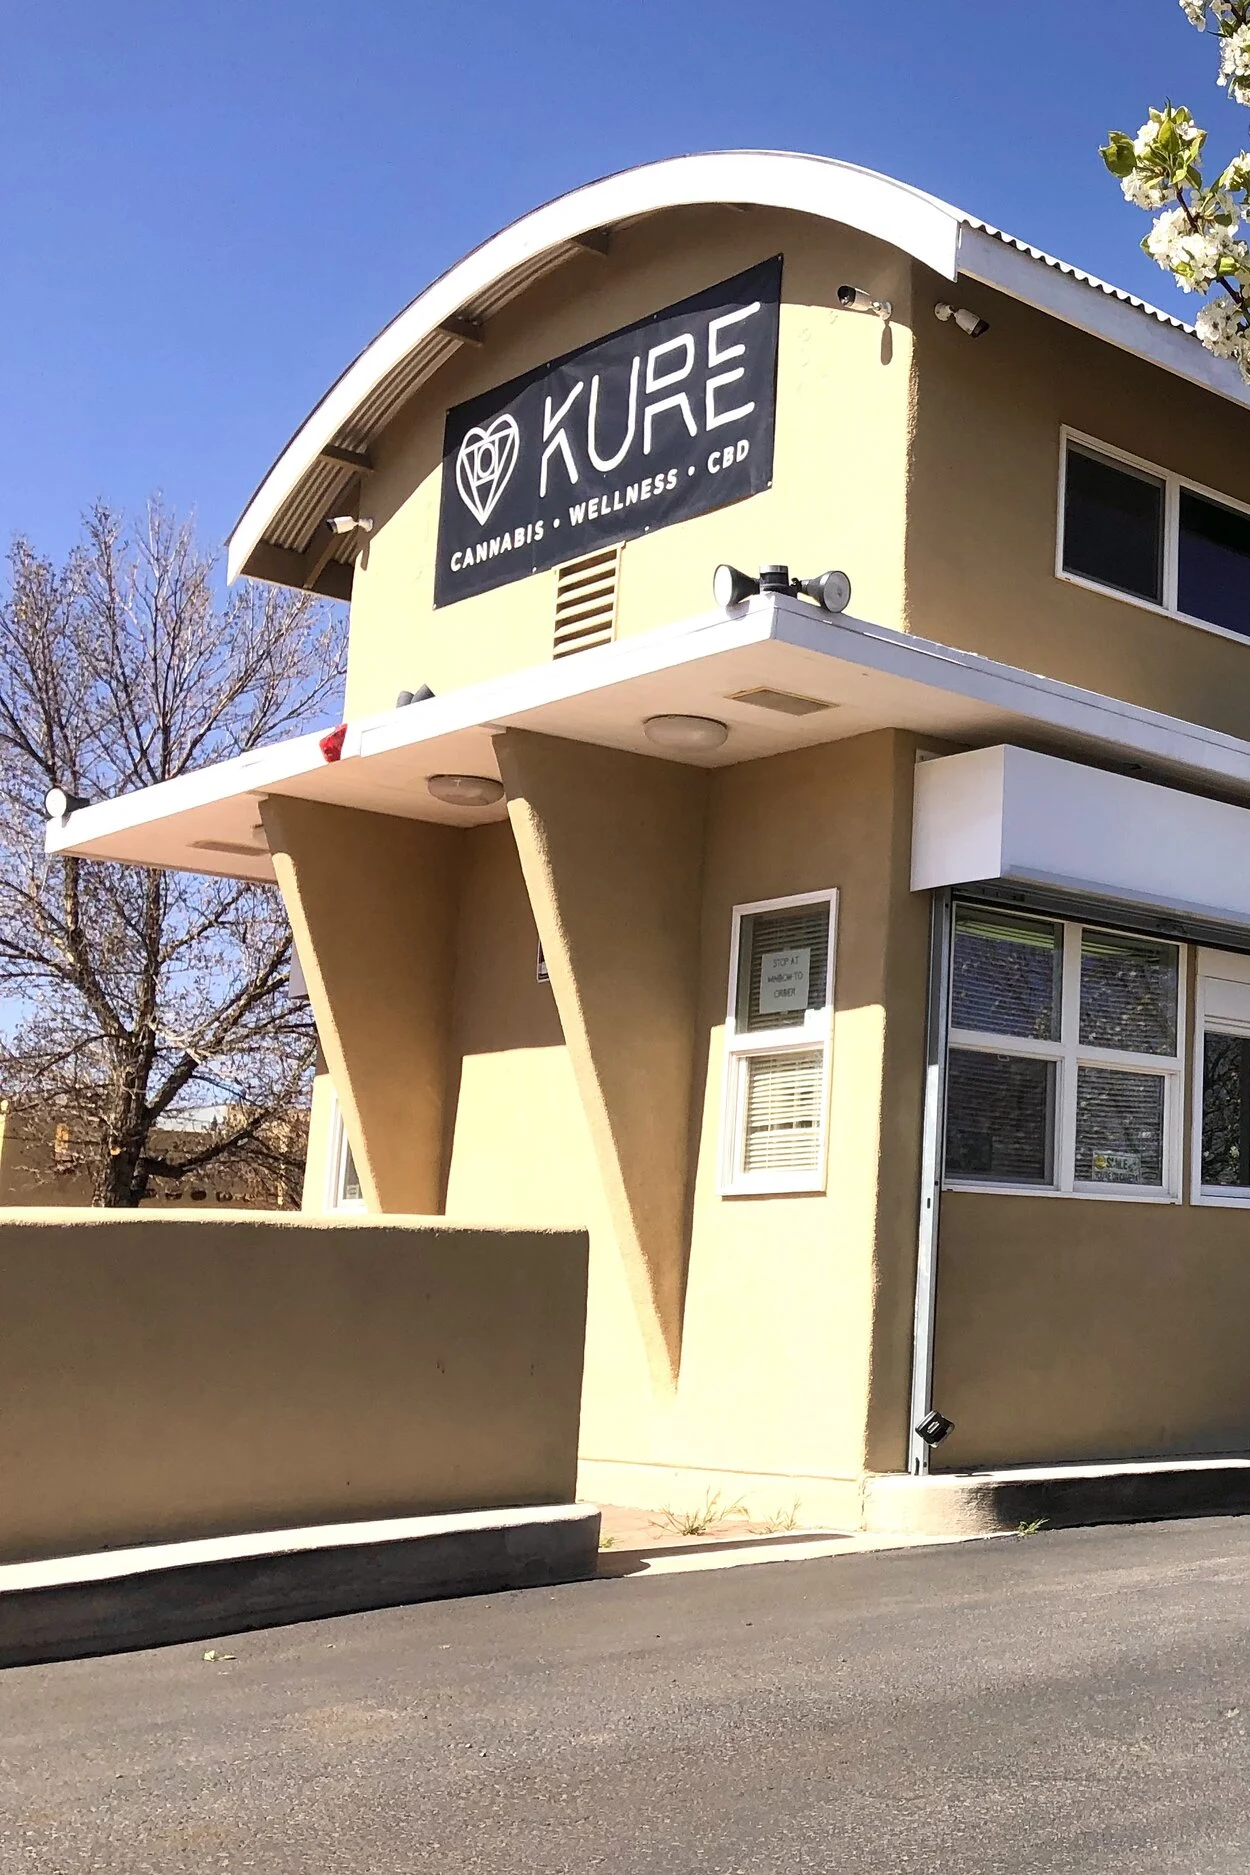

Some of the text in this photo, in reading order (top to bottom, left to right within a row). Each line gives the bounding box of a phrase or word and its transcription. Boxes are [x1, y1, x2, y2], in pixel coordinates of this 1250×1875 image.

[539, 301, 761, 498] KURE
[450, 439, 750, 572] CANNABIS WELLNESS CBD
[773, 956, 799, 968] STOP AT
[794, 971, 804, 981] TO
[774, 988, 796, 998] ORDER
